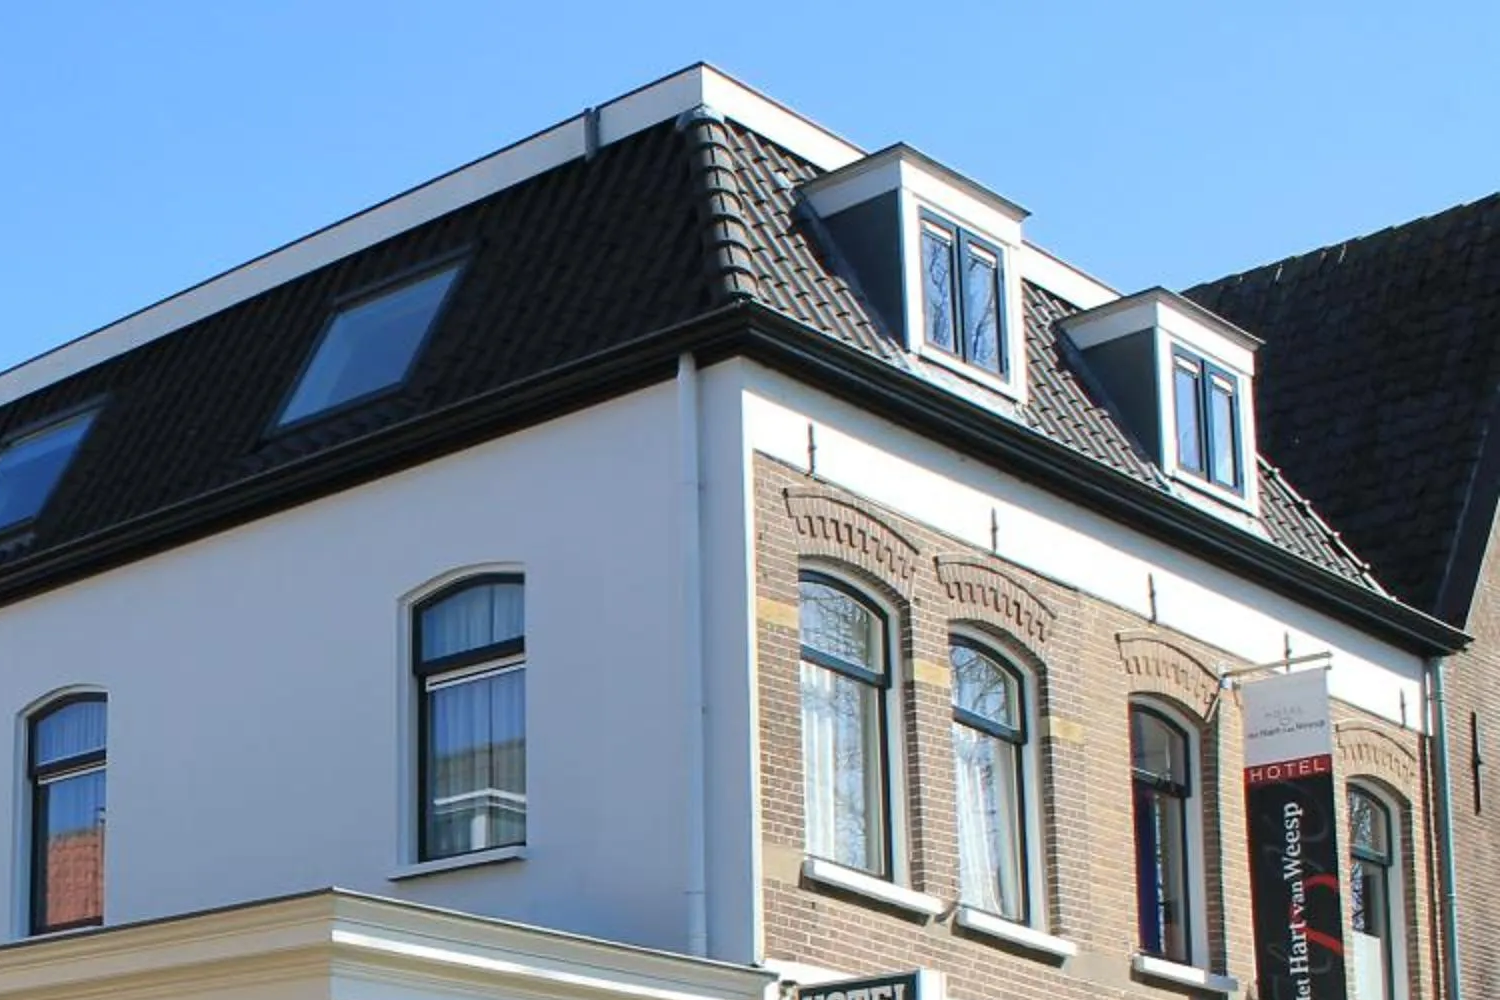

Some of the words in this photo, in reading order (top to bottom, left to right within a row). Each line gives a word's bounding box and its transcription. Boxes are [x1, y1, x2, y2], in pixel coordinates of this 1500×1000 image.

[1251, 758, 1327, 782] HOTEL
[1282, 802, 1303, 880] Weesp
[1291, 881, 1305, 917] van
[1289, 921, 1309, 976] Hart
